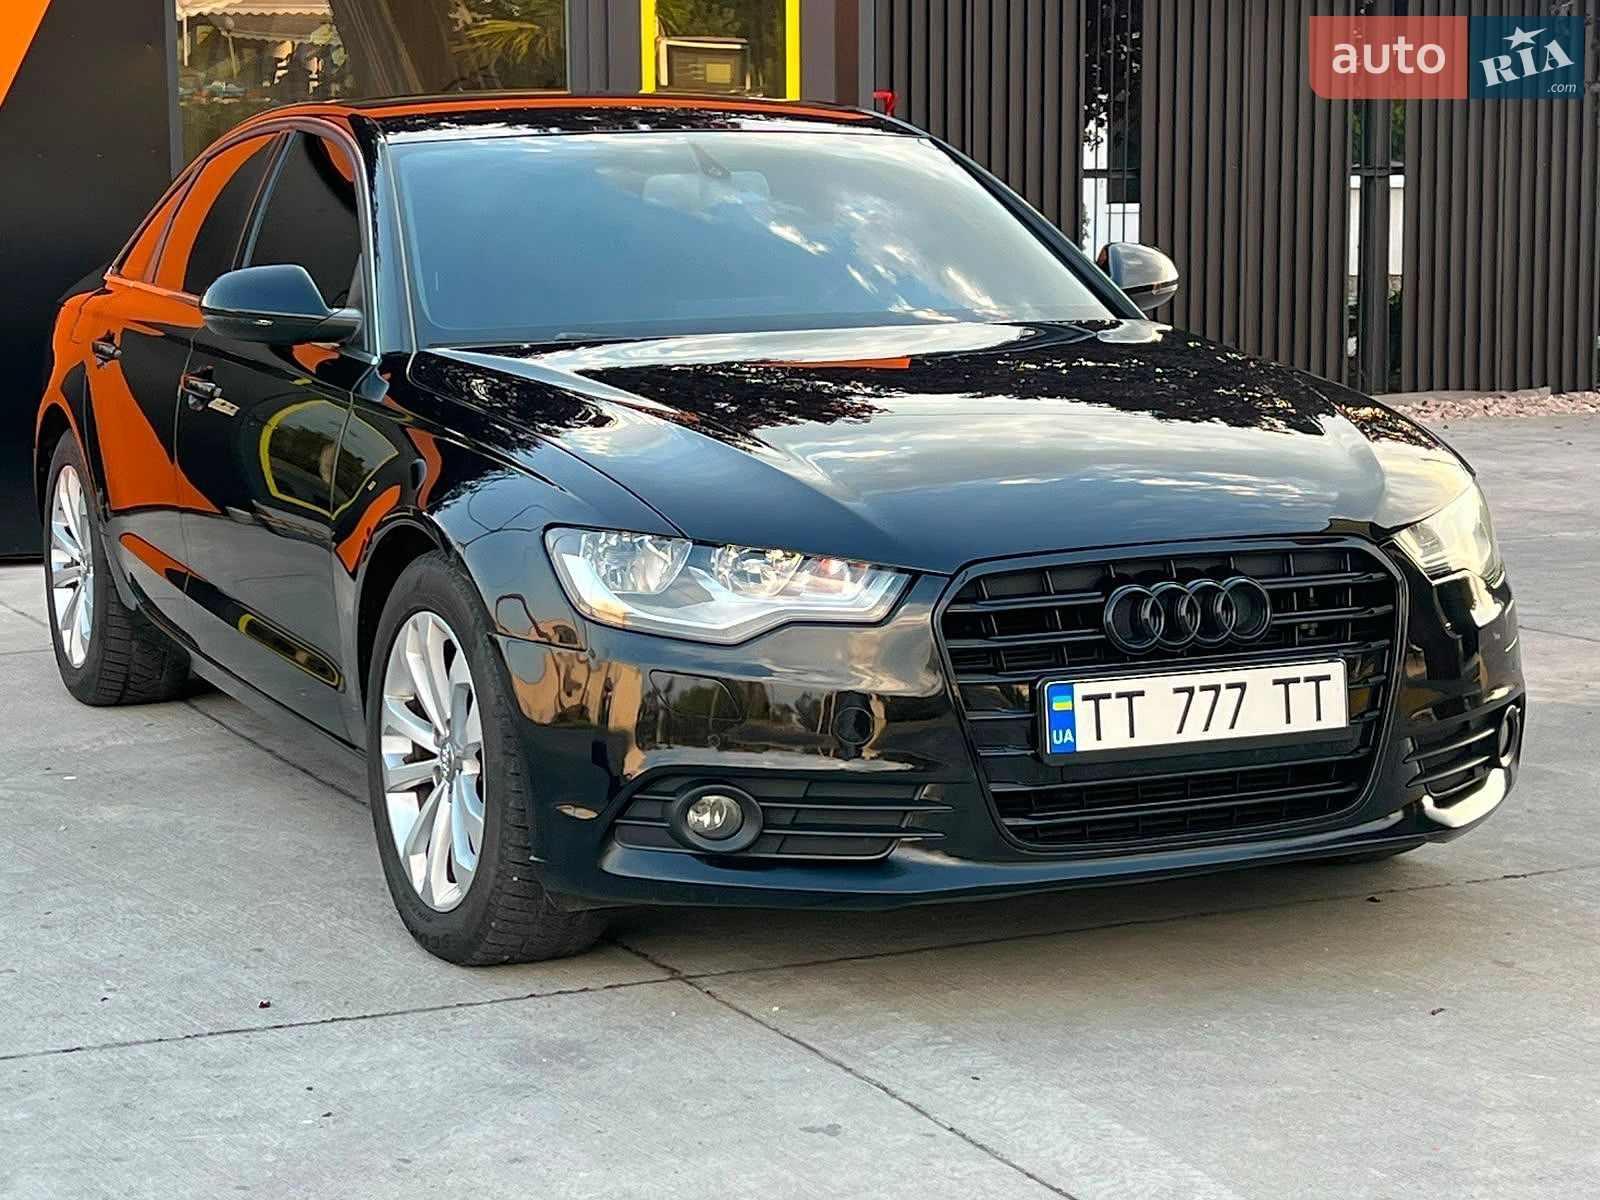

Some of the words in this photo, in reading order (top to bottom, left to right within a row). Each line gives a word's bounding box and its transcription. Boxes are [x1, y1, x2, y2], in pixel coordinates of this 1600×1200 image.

[1081, 690, 1145, 741] TT
[1172, 682, 1247, 734] 777
[1272, 674, 1331, 724] TT
[1052, 729, 1074, 745] UA
